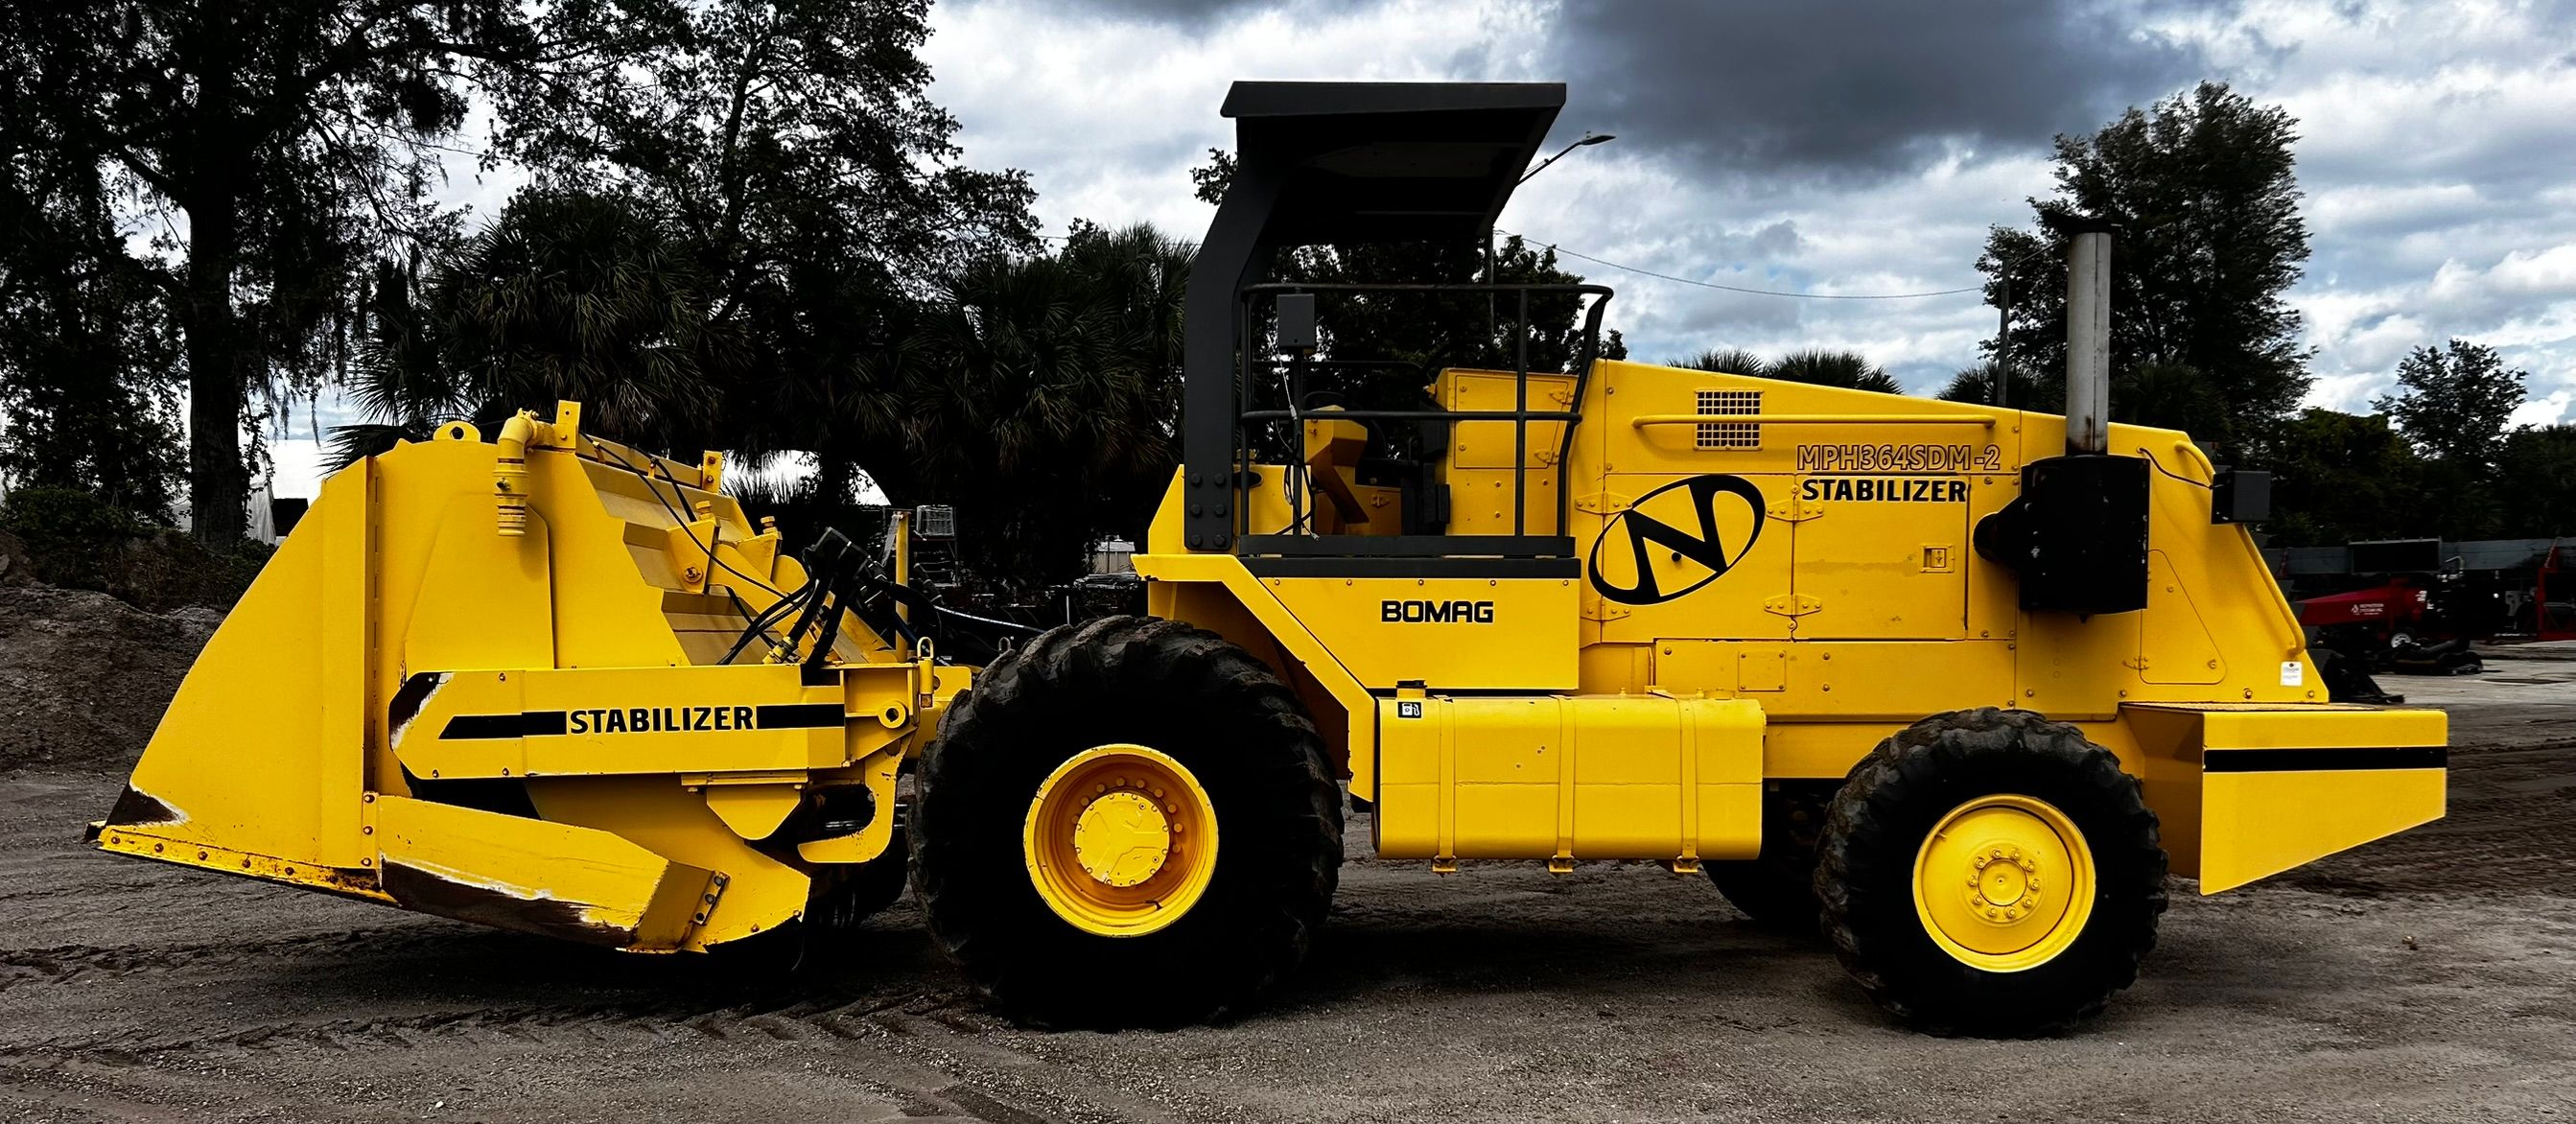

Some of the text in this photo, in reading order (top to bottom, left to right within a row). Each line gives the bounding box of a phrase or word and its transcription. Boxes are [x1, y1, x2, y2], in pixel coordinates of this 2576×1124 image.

[1802, 479, 1966, 503] STABILIZER
[1381, 600, 1494, 623] BOMAG
[570, 706, 754, 735] STABILIZER
